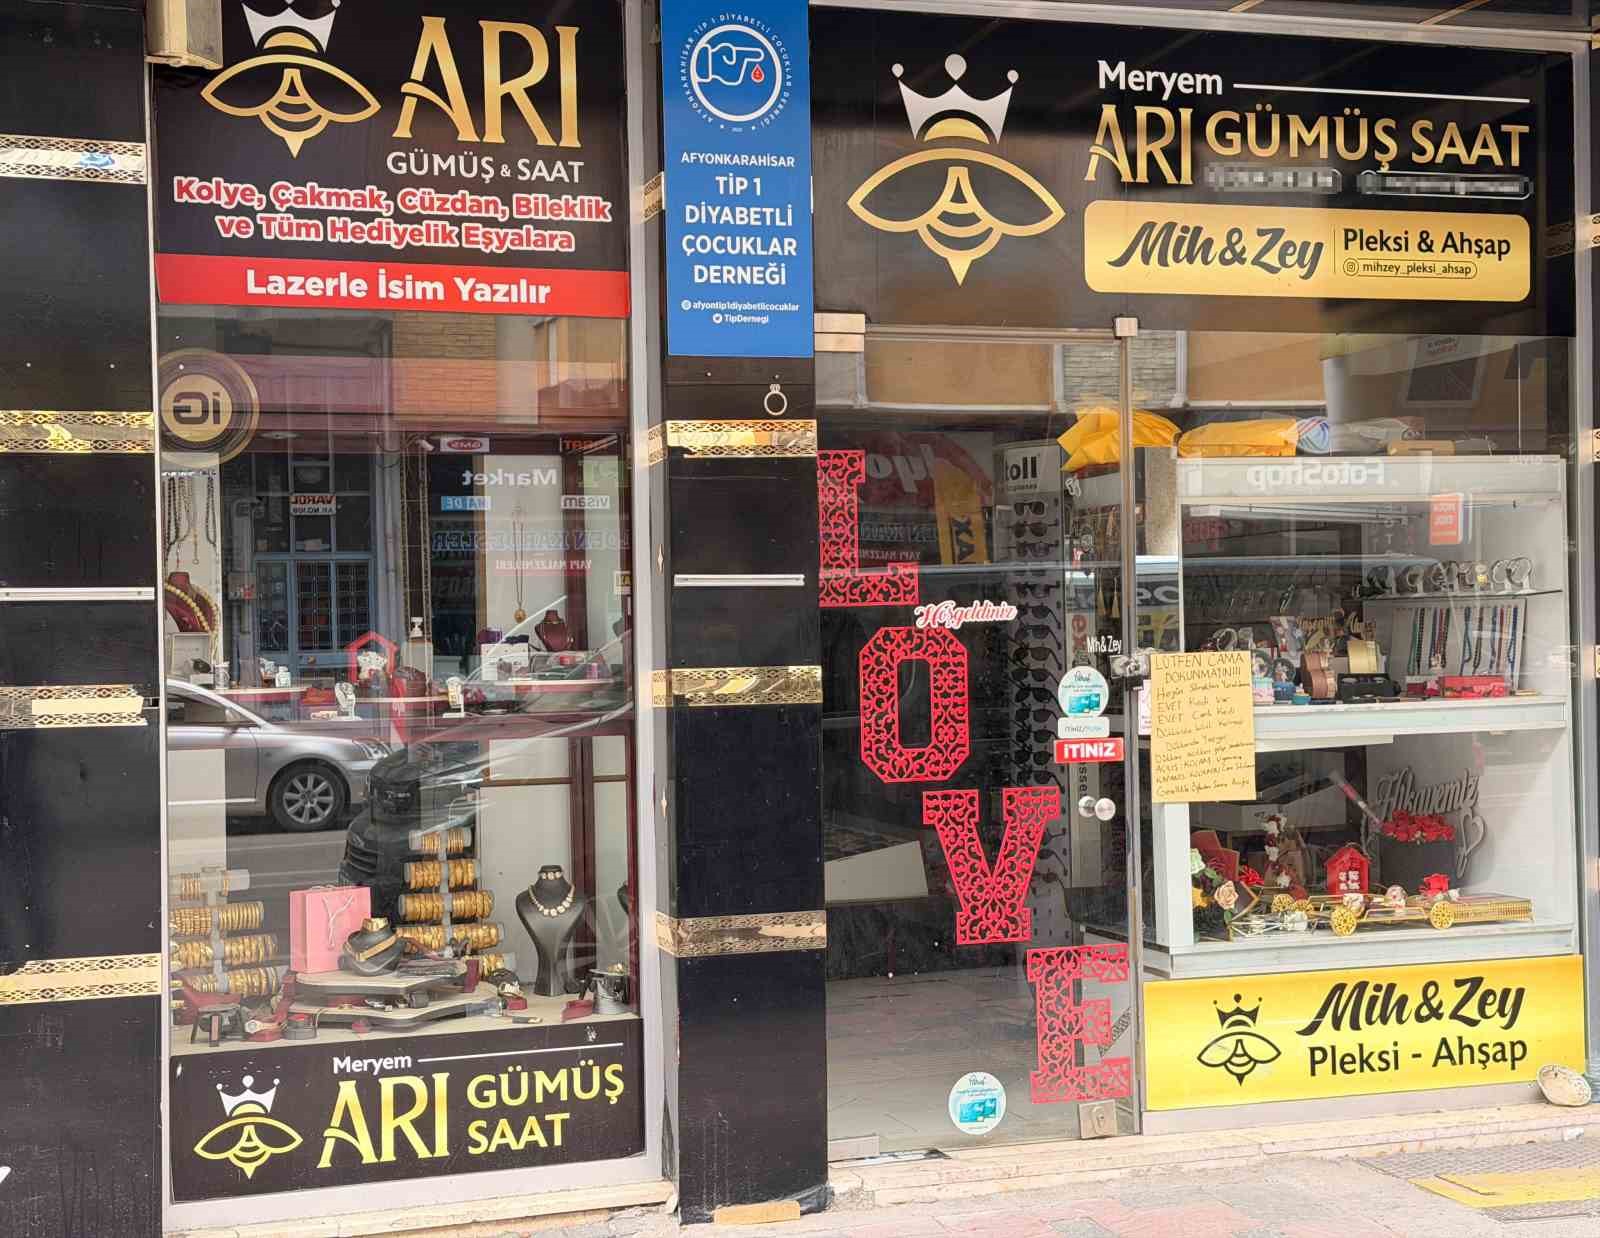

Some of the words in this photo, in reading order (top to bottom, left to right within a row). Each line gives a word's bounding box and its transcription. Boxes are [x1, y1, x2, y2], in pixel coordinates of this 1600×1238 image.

[392, 16, 582, 148] ARI
[1097, 59, 1223, 100] Meryem
[681, 151, 795, 168] AFYONKARAHİSAR
[1084, 104, 1194, 186] ARI
[1205, 103, 1398, 171] GÜMÜŞ
[1411, 120, 1530, 167] SAAT
[386, 147, 495, 183] GÜMÜŞ
[500, 164, 512, 177] &
[517, 159, 584, 184] SAAT
[715, 172, 749, 196] TİP
[753, 178, 761, 196] 1
[174, 176, 265, 210] Kolye,
[271, 181, 393, 216] Çakmak,
[398, 187, 509, 220] Cüzdan,
[514, 193, 612, 223] Bileklik
[685, 202, 793, 227] DİYABETLİ
[216, 217, 254, 238] ve
[258, 215, 324, 241] Tüm
[328, 219, 459, 251] Hediyelik
[463, 225, 575, 255] Eşyalara
[682, 234, 797, 257] ÇOCUKLAR
[1344, 228, 1409, 253] Pleksi
[1417, 230, 1434, 253] &
[1441, 231, 1511, 262] Ahşap
[246, 269, 368, 300] Lazerle
[377, 269, 446, 302] İsim
[453, 276, 552, 304] Yazılır
[693, 262, 787, 286] DERNEĞİ
[333, 1053, 411, 1078] Meryem
[1308, 1040, 1400, 1077] Pleksi
[1432, 1036, 1528, 1070] Ahşap
[466, 1060, 625, 1110] GÜMÜŞ
[316, 1072, 450, 1169] ARI
[468, 1113, 571, 1154] SAAT
